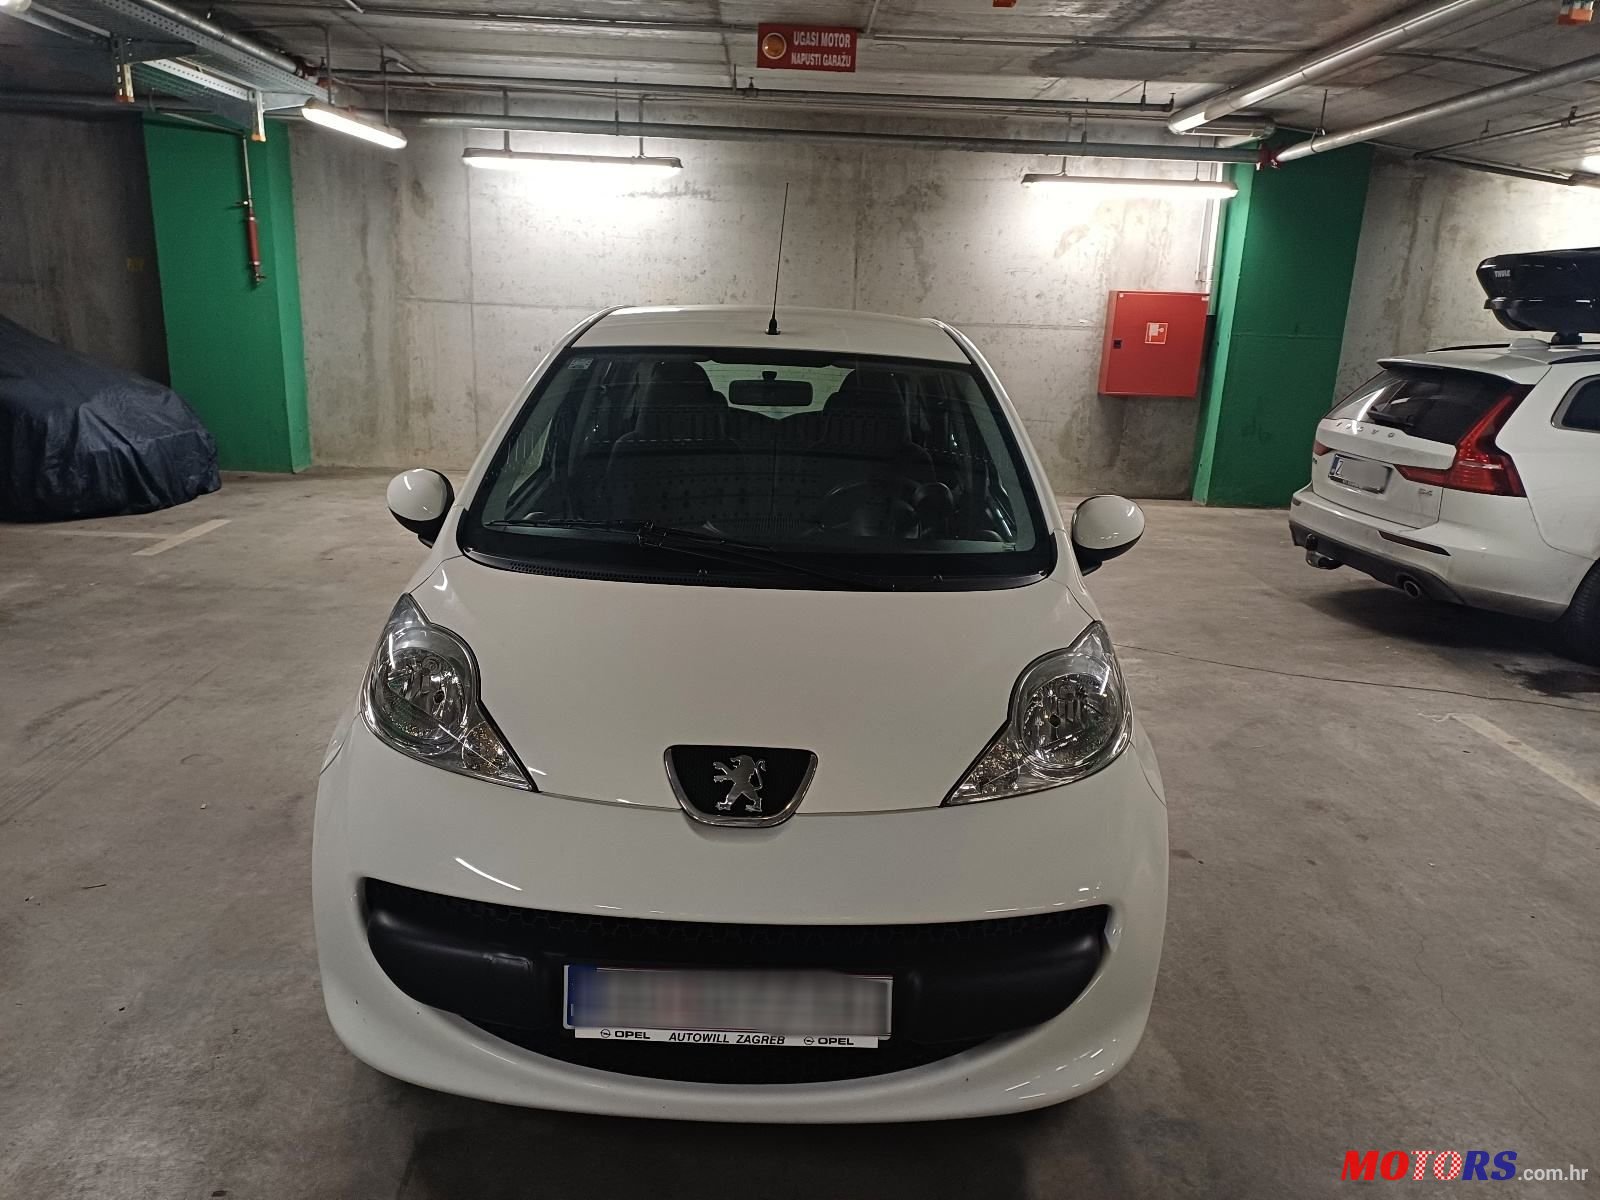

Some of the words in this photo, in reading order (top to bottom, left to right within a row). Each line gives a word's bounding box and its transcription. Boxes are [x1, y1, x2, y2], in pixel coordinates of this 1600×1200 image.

[793, 31, 819, 47] UGASI
[821, 32, 851, 48] MOTOR
[791, 52, 821, 66] NAPUSTI
[822, 51, 852, 67] GARAŽU
[1494, 269, 1511, 278] THULE
[614, 1030, 651, 1040] OPEL
[668, 1032, 730, 1044] AUTOWILL
[736, 1034, 786, 1045] ZAGREB
[817, 1037, 855, 1046] OPEL
